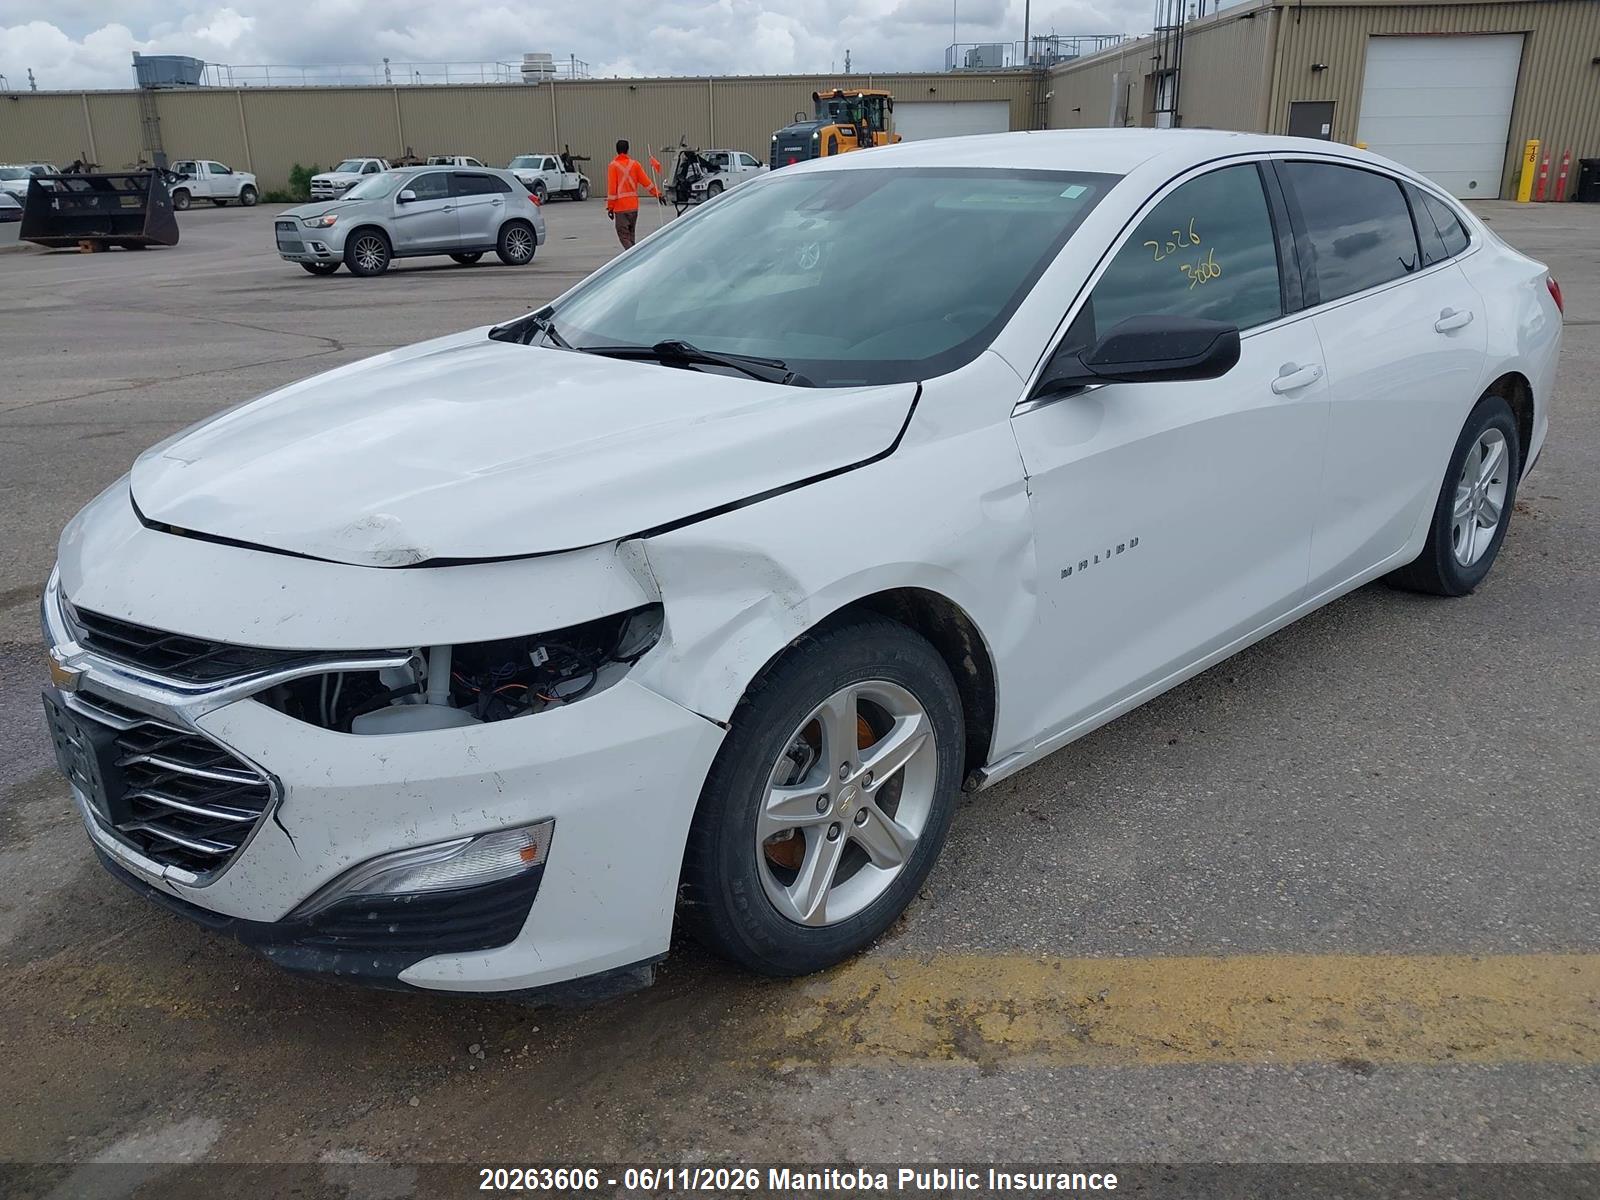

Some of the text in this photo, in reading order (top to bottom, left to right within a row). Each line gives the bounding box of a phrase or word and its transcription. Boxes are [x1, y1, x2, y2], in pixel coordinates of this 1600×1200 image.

[1143, 217, 1201, 261] 2026
[1180, 247, 1221, 290] 3606
[1060, 536, 1139, 580] MALIBU
